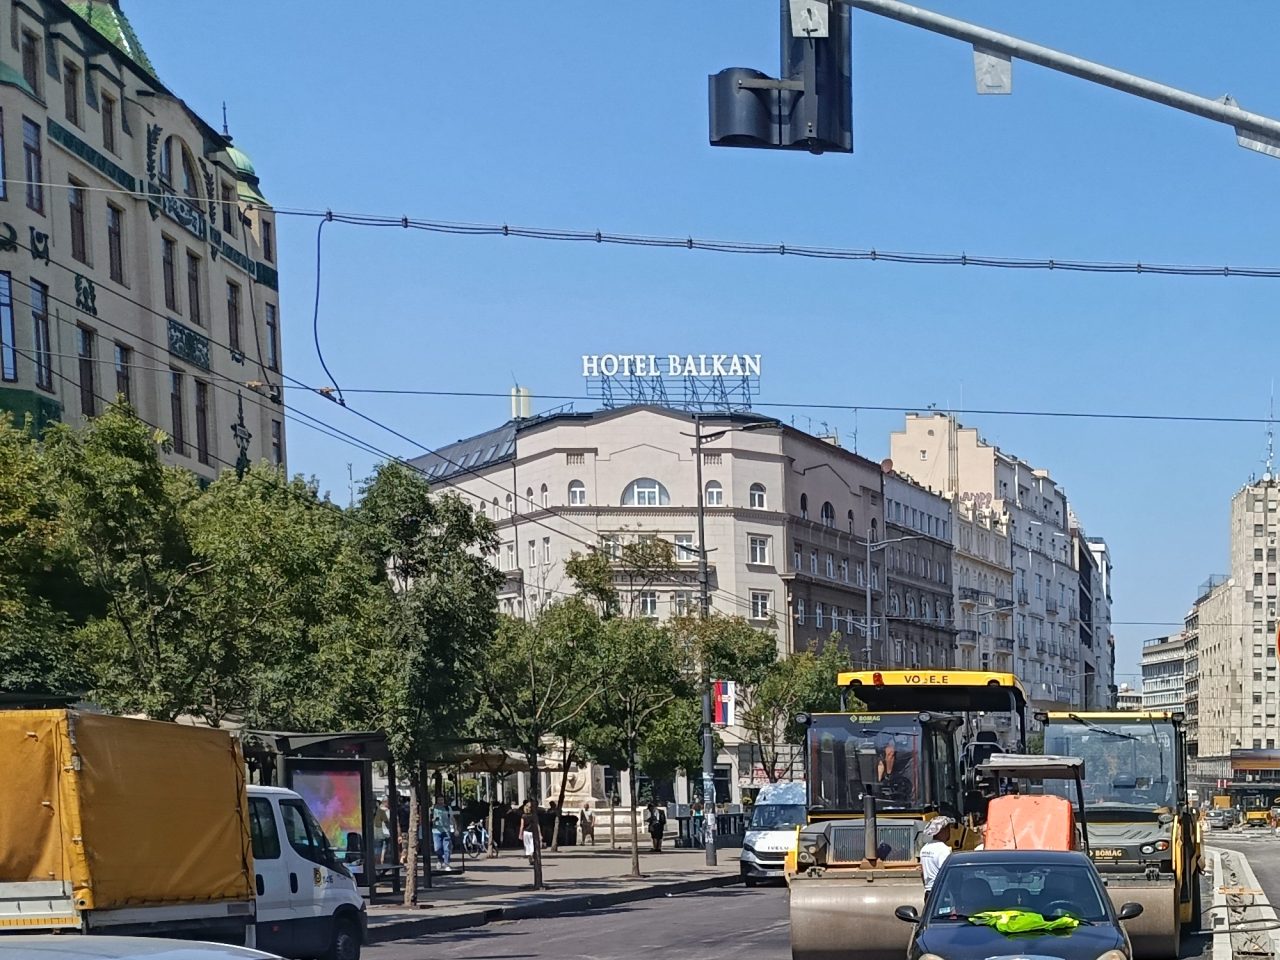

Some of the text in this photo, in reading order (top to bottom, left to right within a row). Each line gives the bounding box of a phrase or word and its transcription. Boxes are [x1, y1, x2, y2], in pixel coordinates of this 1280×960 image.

[582, 353, 762, 377] HOTEL BALKAN
[904, 675, 949, 684] VOEE
